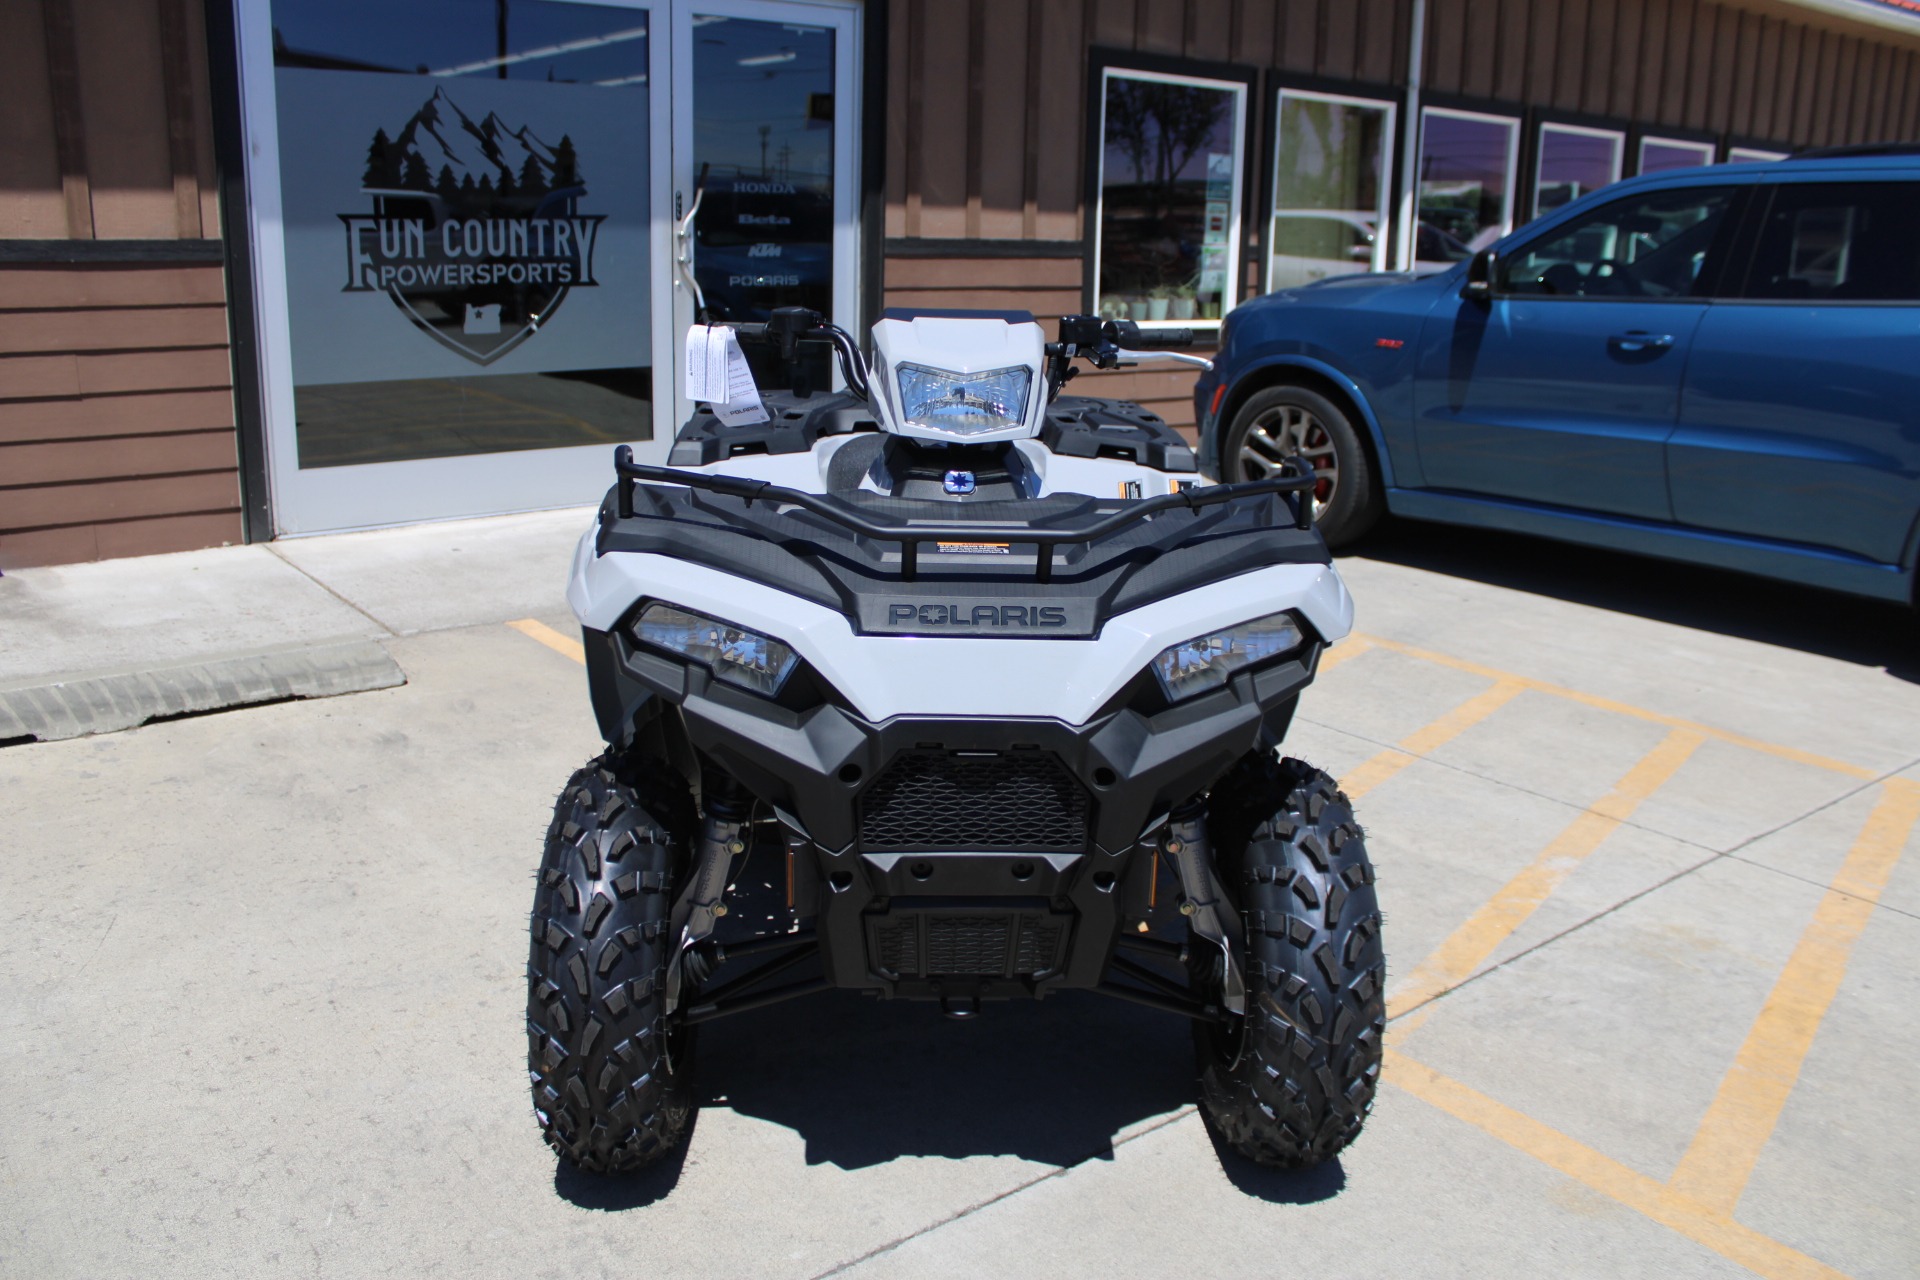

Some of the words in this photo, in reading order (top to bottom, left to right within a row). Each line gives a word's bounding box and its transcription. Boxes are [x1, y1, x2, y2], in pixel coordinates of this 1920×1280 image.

[733, 182, 796, 194] HONDA
[738, 214, 791, 224] Beta
[350, 218, 425, 288] FUN
[442, 218, 596, 282] COUNTRY
[748, 243, 782, 257] KTM
[381, 263, 572, 287] POWERSPORTS
[729, 275, 799, 287] POLARIS
[729, 405, 759, 416] POLARIS
[888, 604, 1067, 627] POLARIS
